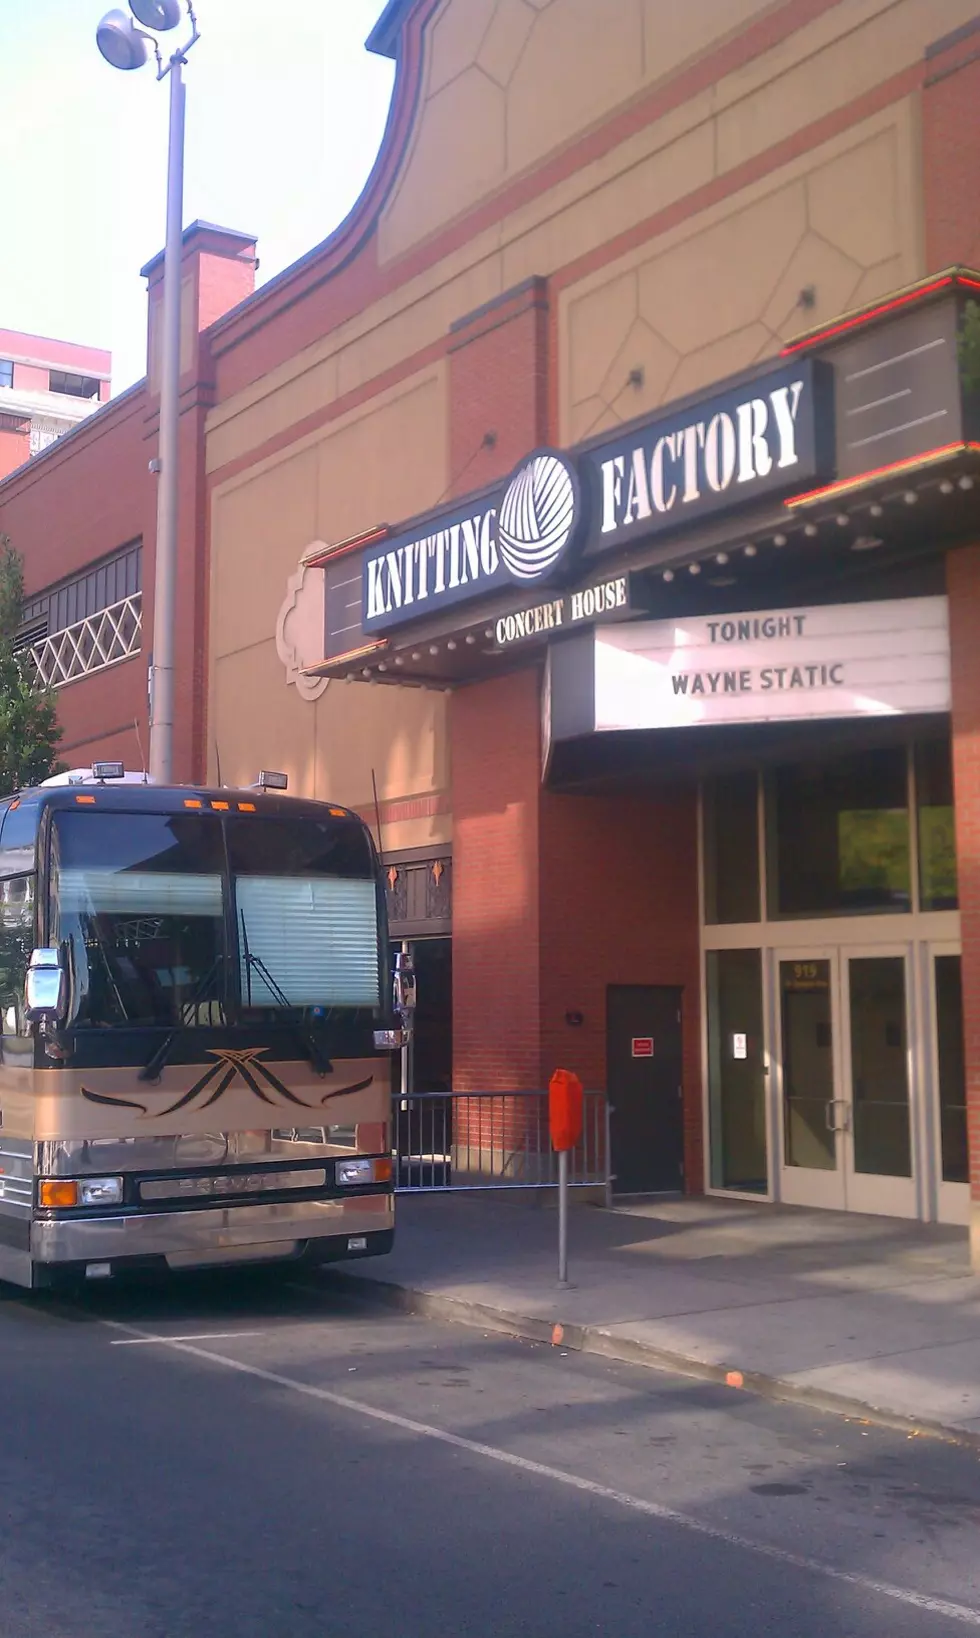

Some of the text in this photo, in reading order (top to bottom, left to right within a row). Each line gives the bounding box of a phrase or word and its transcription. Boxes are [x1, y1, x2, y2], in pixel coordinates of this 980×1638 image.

[366, 380, 803, 619] KNITTING FACTORY
[496, 578, 627, 644] CONCERT HOUSE
[707, 615, 807, 642] TONIGHT
[672, 664, 844, 694] WAYNE STATIC
